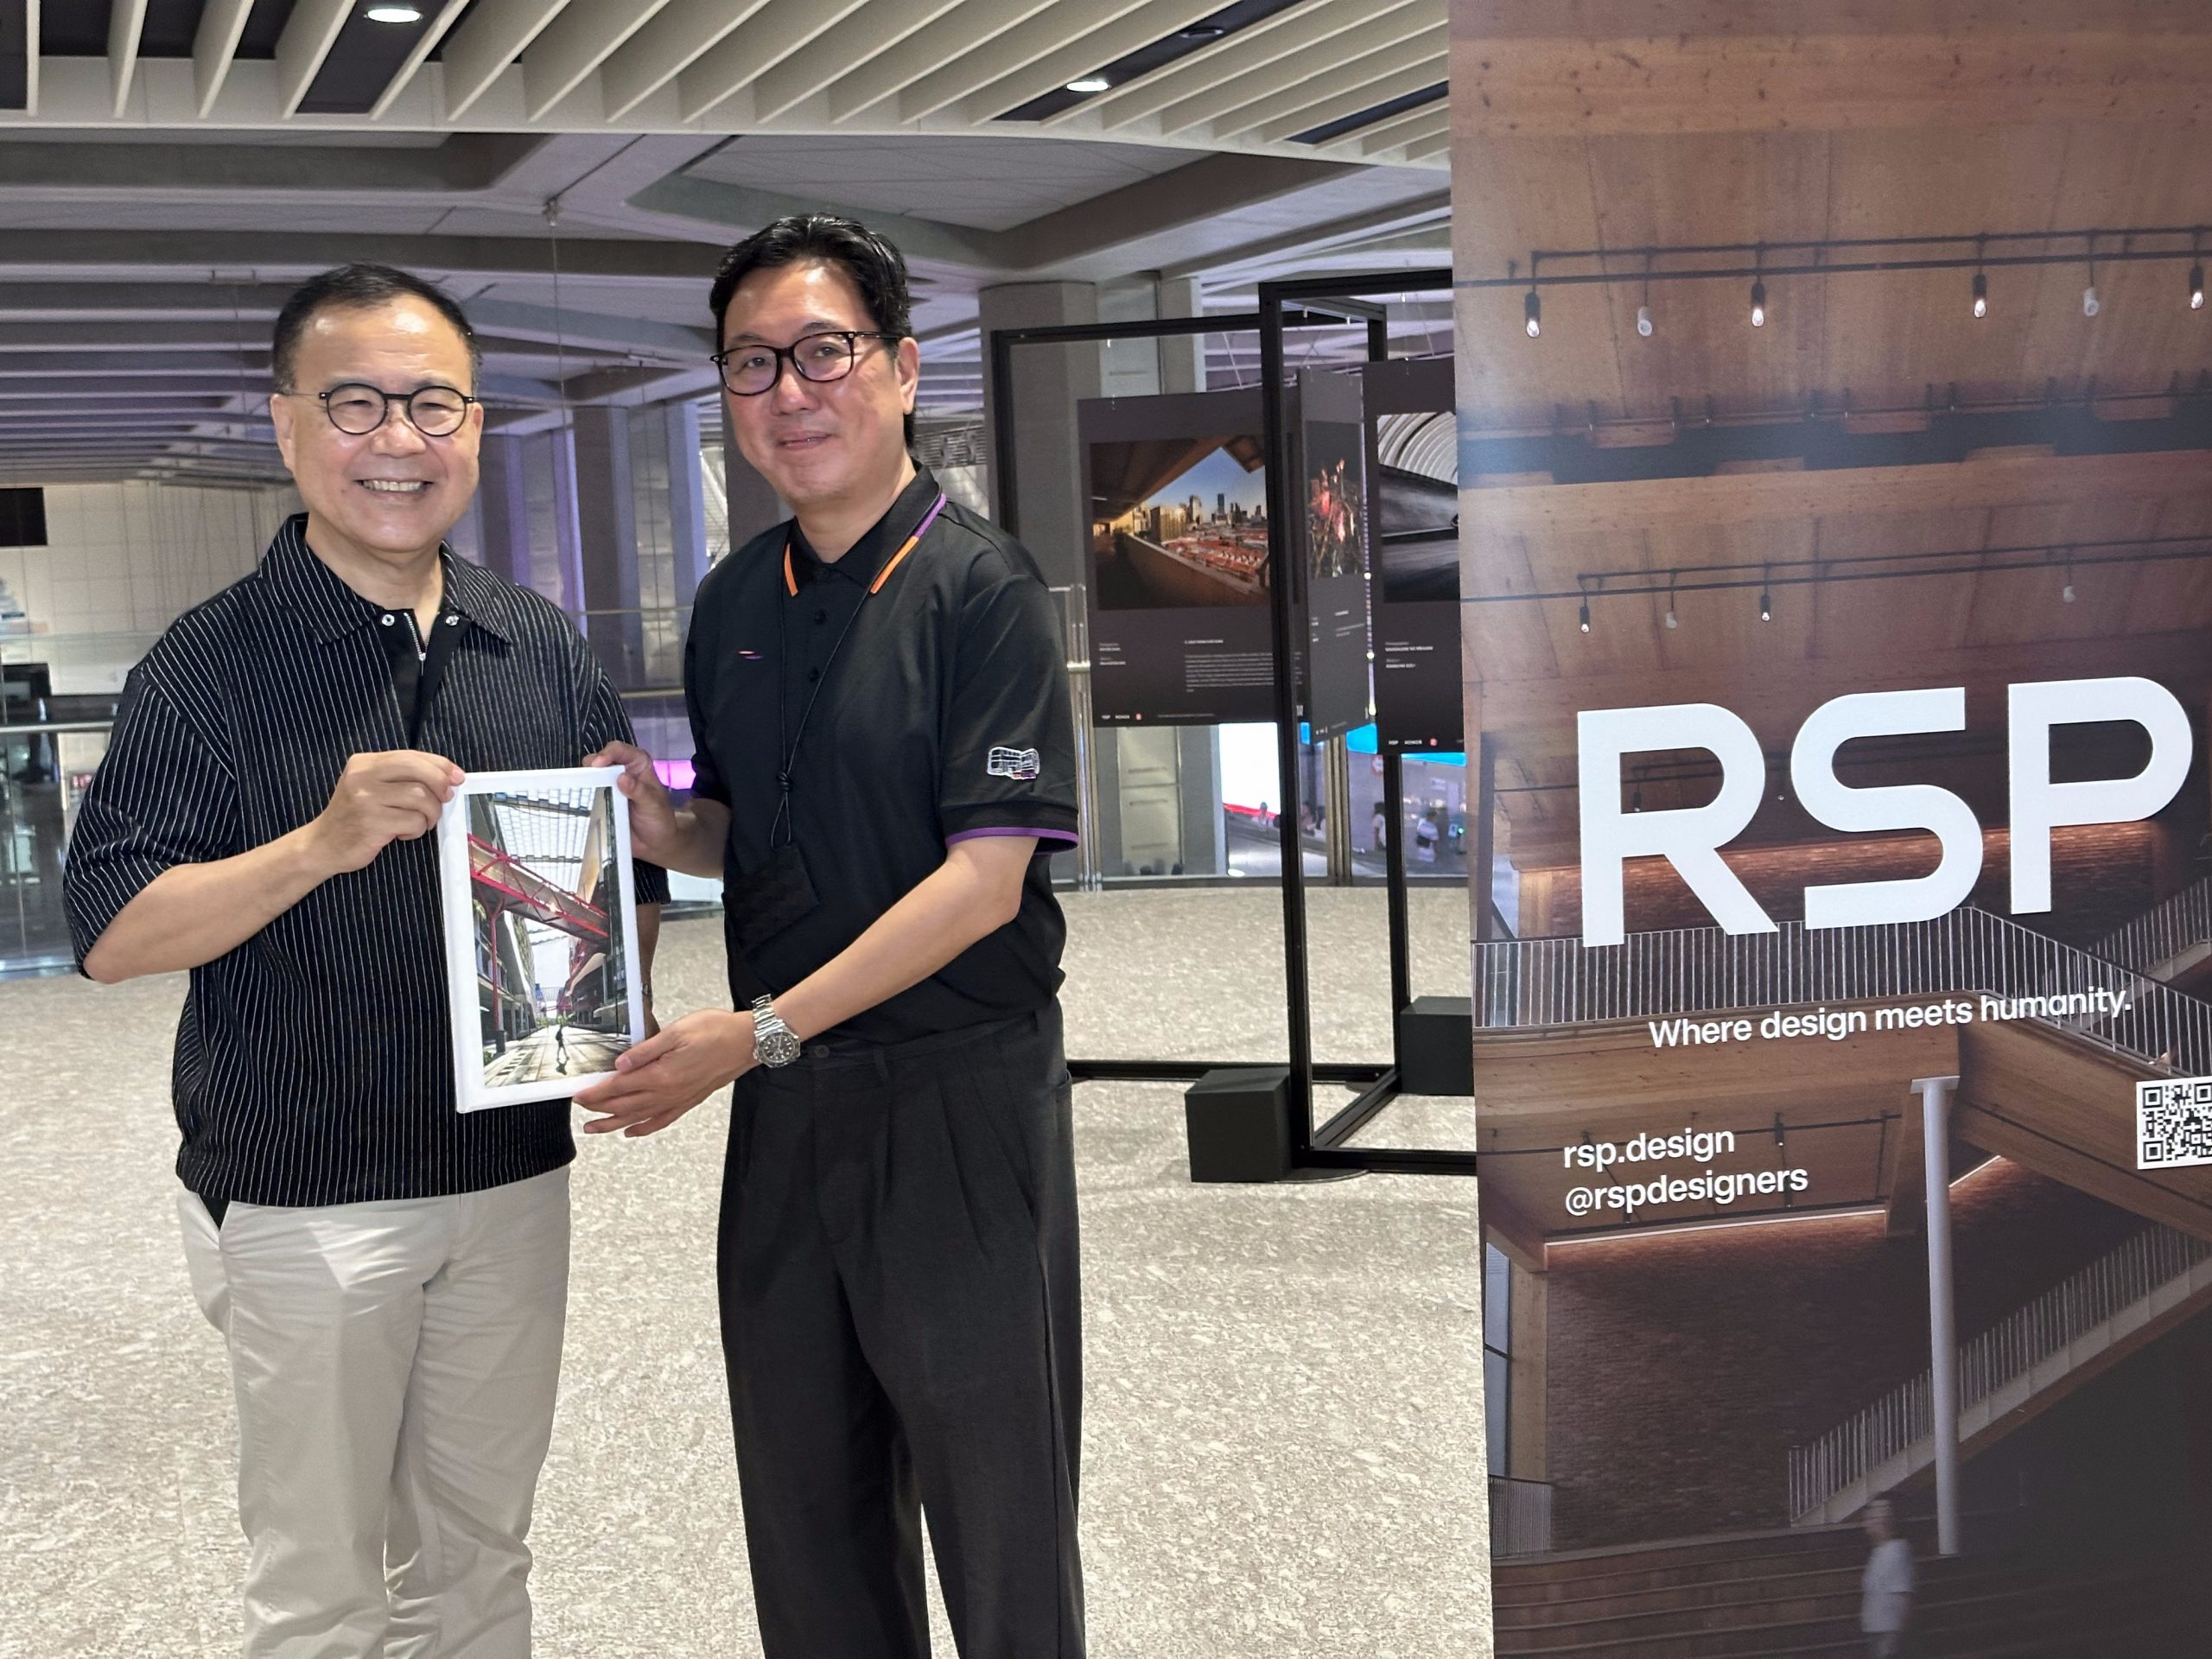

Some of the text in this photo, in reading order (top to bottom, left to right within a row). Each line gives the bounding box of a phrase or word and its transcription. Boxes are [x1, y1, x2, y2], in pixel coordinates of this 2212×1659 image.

[1577, 676, 2193, 948] RSP
[1648, 986, 2132, 1048] Where design meets humanity.
[1564, 1128, 1734, 1173] rsp.design
[1565, 1168, 1808, 1217] @rspdesigners
